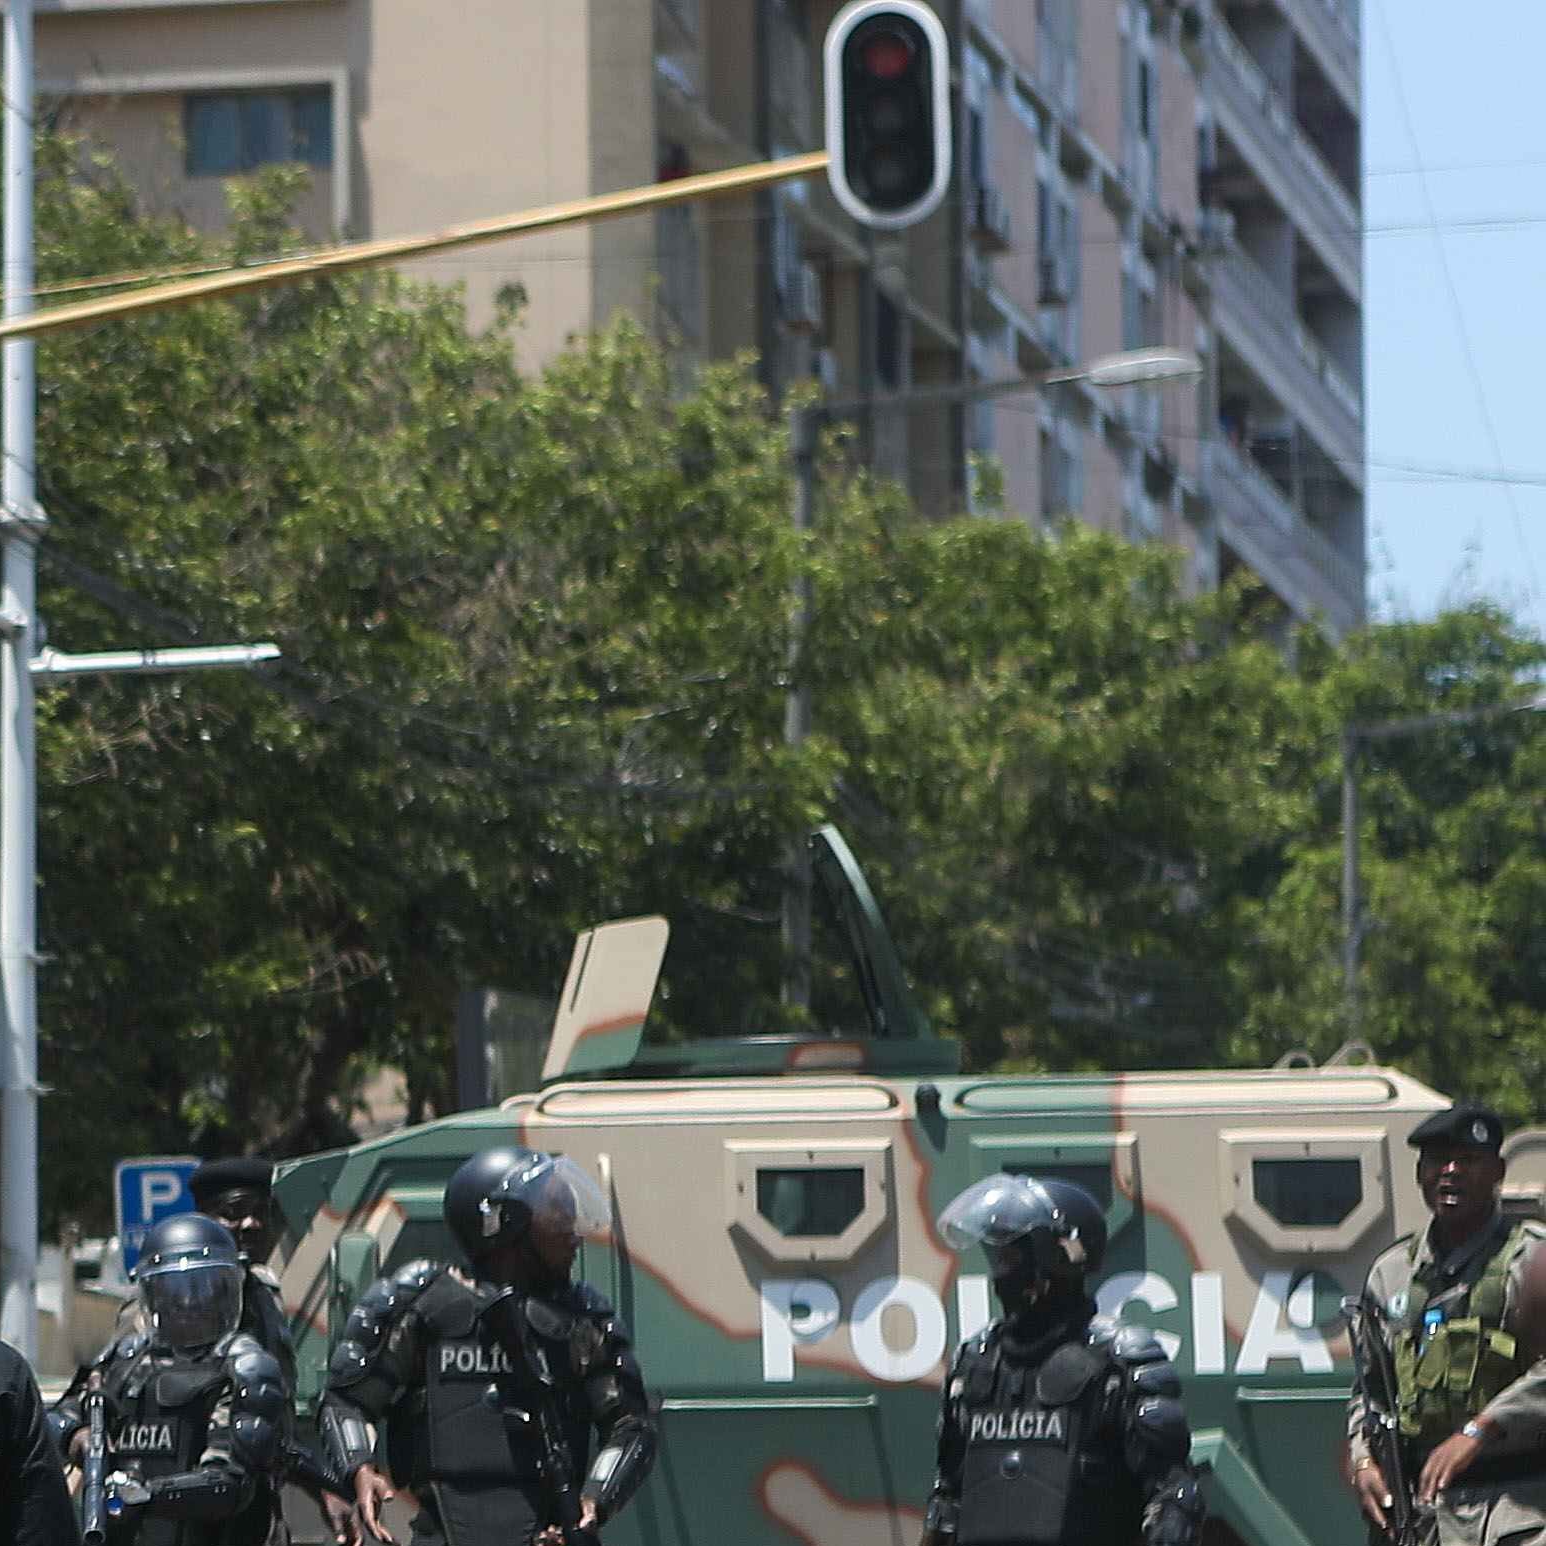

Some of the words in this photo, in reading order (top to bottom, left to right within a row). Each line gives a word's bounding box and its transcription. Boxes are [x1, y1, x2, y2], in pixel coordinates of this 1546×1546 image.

[141, 1173, 182, 1221] P
[761, 1271, 1335, 1383] POCIA
[970, 1407, 1062, 1440] POLÍCIA
